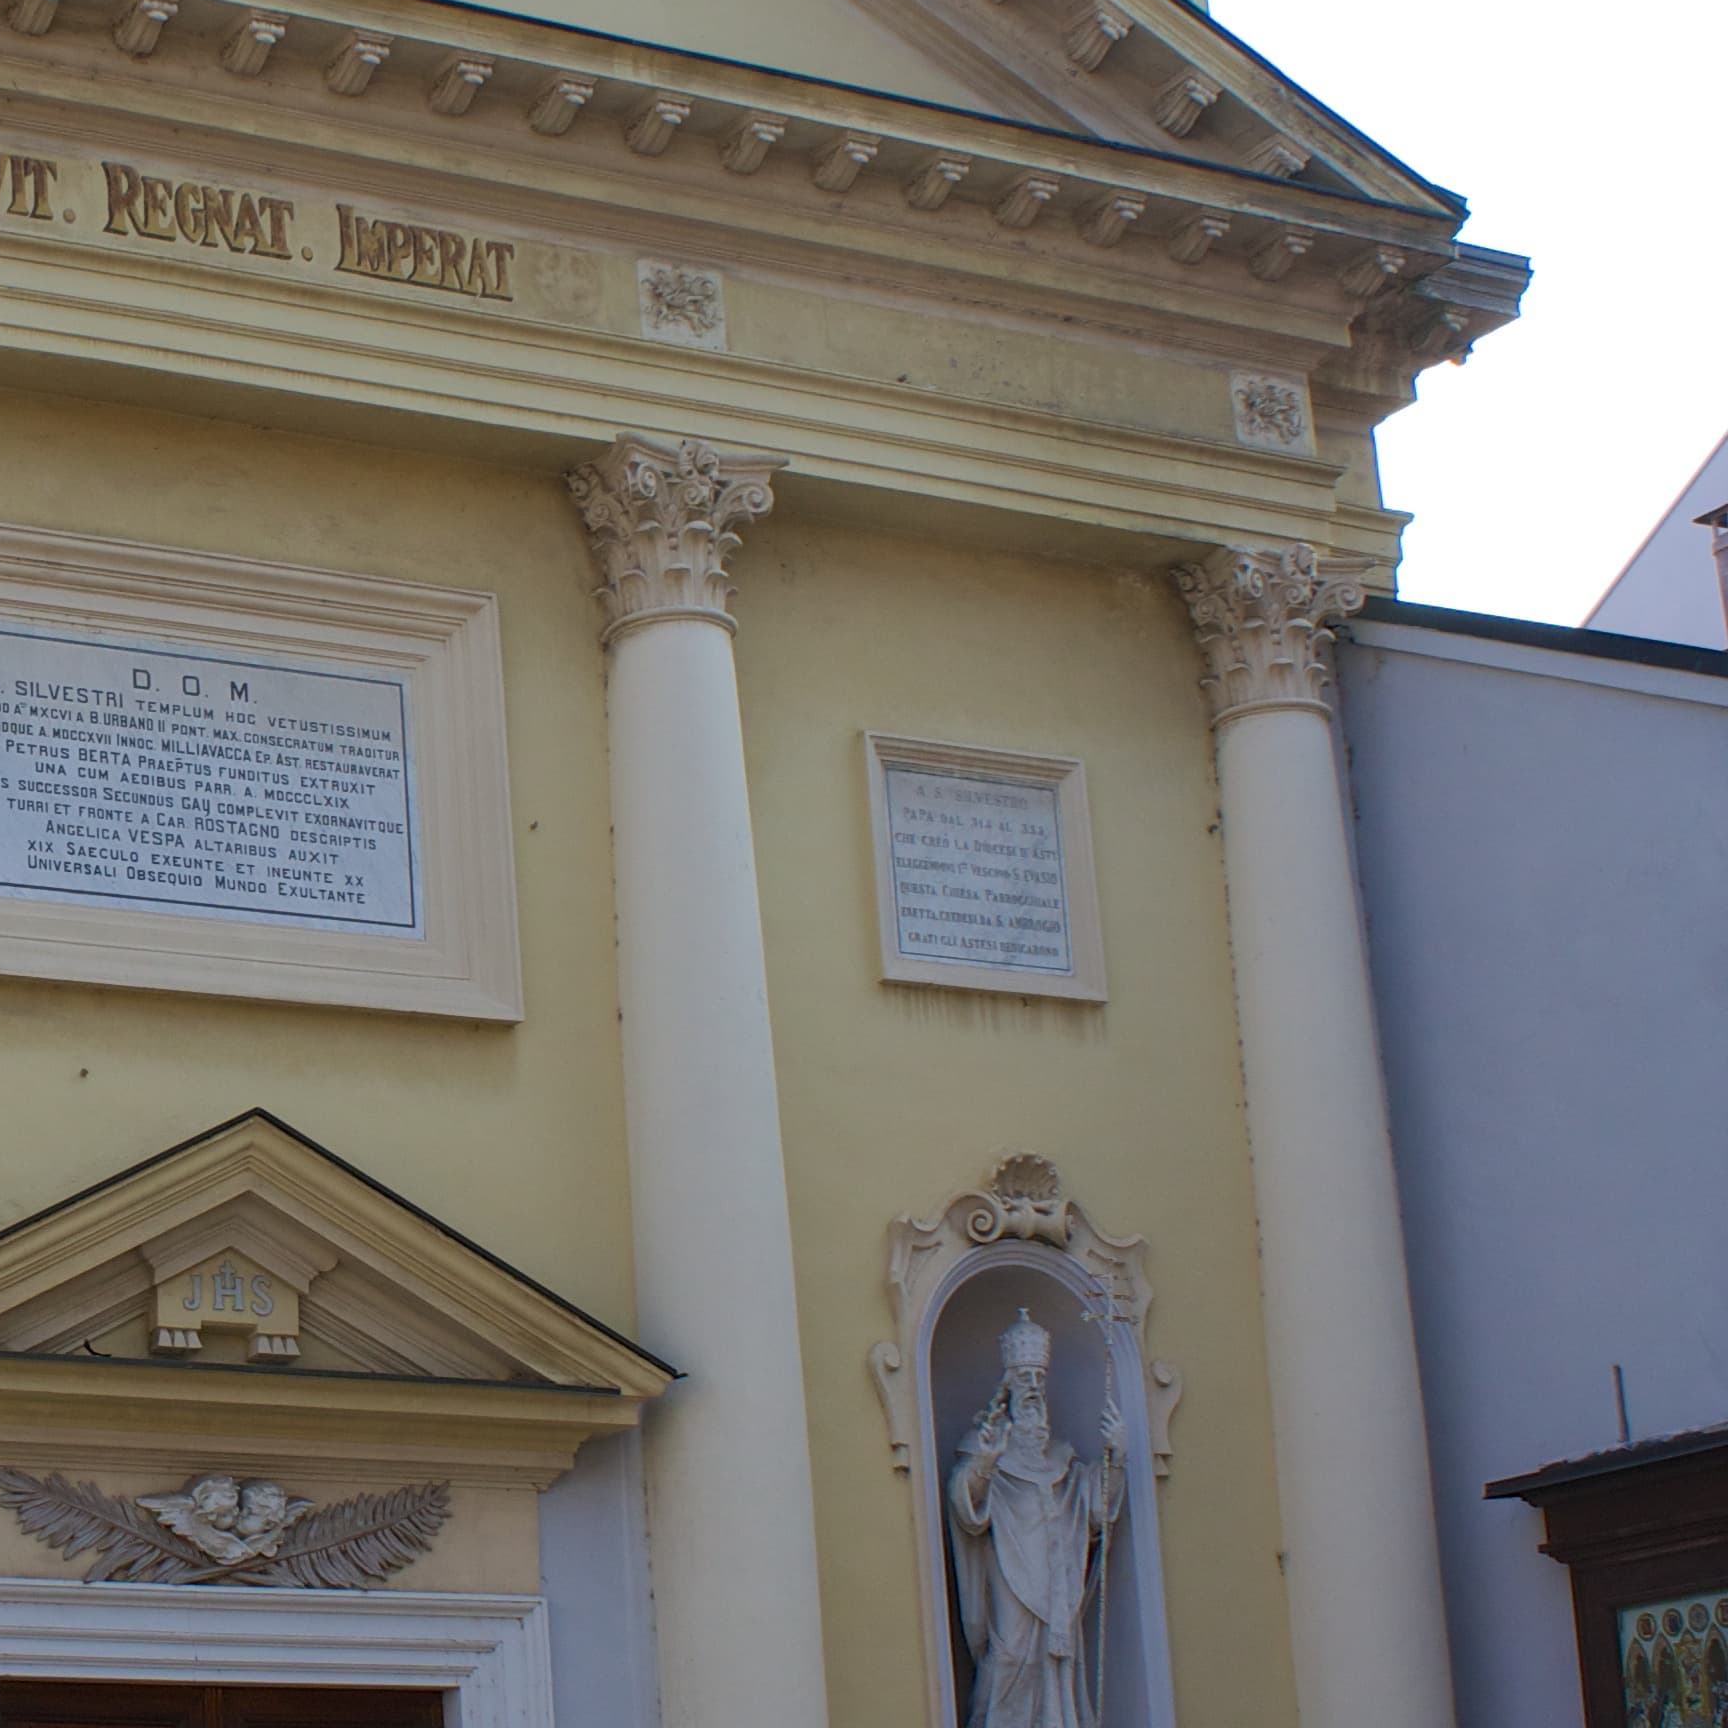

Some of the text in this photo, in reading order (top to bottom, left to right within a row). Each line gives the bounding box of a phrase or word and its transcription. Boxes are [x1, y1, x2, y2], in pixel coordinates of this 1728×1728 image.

[334, 202, 515, 302] IMPERAT
[15, 680, 124, 709] SILVESTRI
[135, 699, 214, 720] TEMPLUM
[225, 711, 256, 726] HOC
[267, 716, 392, 742] VETUSTISSIMUM
[132, 668, 160, 693] D.
[230, 680, 258, 705] M.
[29, 706, 72, 721] MXCVI
[75, 711, 85, 723] A
[339, 744, 400, 761] TRADITUR
[52, 727, 112, 746] MDCCXVII
[160, 739, 252, 762] MILLIAVACCA
[305, 758, 401, 780] RESTAURAVERAT
[5, 739, 71, 760] PETRUS
[78, 747, 132, 767] BERTA
[218, 766, 290, 786] FUNDITUS
[300, 776, 376, 797] EXTRUXIT
[35, 761, 67, 777] UNA
[77, 767, 109, 781] CUM
[119, 772, 186, 790] AEDIBUS
[264, 788, 350, 810] MDCCCLXIX
[6, 797, 49, 813] TURRI
[53, 803, 72, 817] ET
[78, 806, 133, 823] FRONTE
[140, 813, 151, 825] A
[194, 816, 280, 840] ROSTAGNO
[290, 830, 377, 851] DESCRIPTIS
[17, 779, 98, 800] SUCCESSOR
[103, 787, 174, 809] SECUNDUS
[217, 802, 300, 823] COMPLEVIT
[304, 811, 404, 835] EXORNAVITQUE
[903, 806, 935, 823] PAPA
[940, 813, 964, 826] DAL
[998, 821, 1013, 833] AL
[27, 839, 365, 888] XIX SAECULO EXEUNTE ET INEUNTE XX
[45, 819, 340, 865] ANGELICA VESPA ALTARIBUS AUXIT
[894, 832, 916, 845] CHE
[954, 839, 970, 851] LA
[27, 855, 366, 905] UNIVERSALI OBSEQUIO MUNDO EXULTANTE
[942, 884, 979, 900] CHIESA
